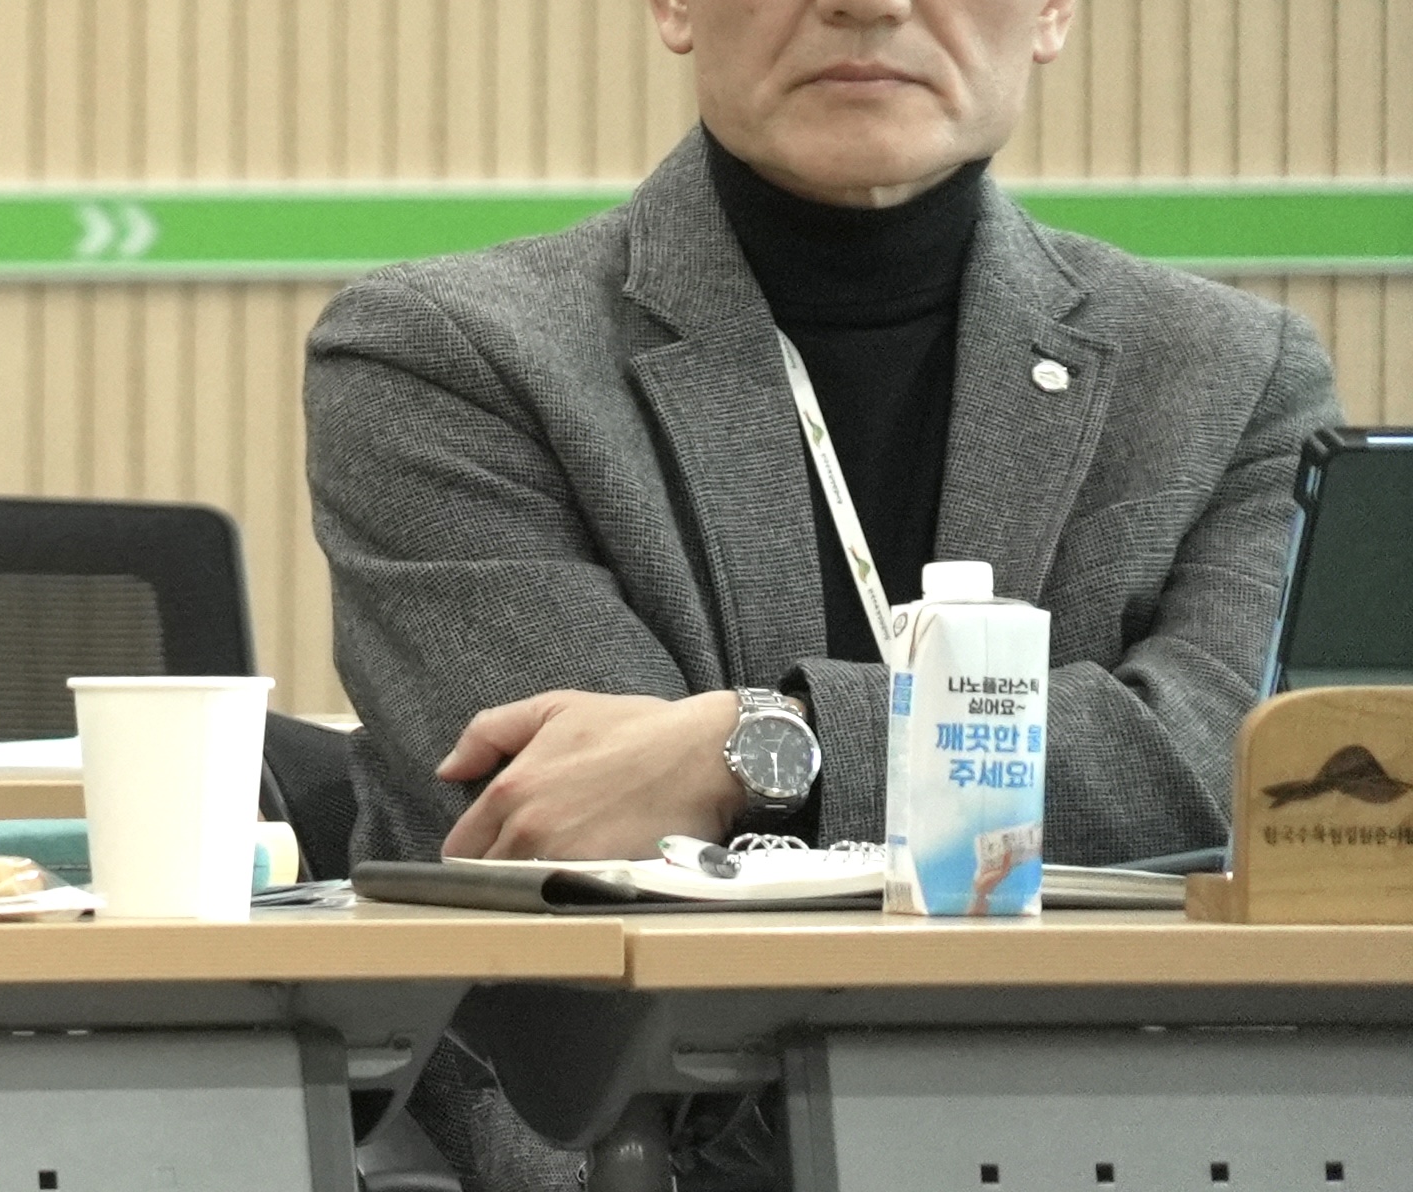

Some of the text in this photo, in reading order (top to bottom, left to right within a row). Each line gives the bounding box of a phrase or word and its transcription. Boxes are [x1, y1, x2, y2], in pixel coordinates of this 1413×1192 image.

[948, 676, 1040, 694] 나노플라스틱
[936, 723, 1020, 753] 깨끗한
[949, 759, 1035, 788] 주세요!
